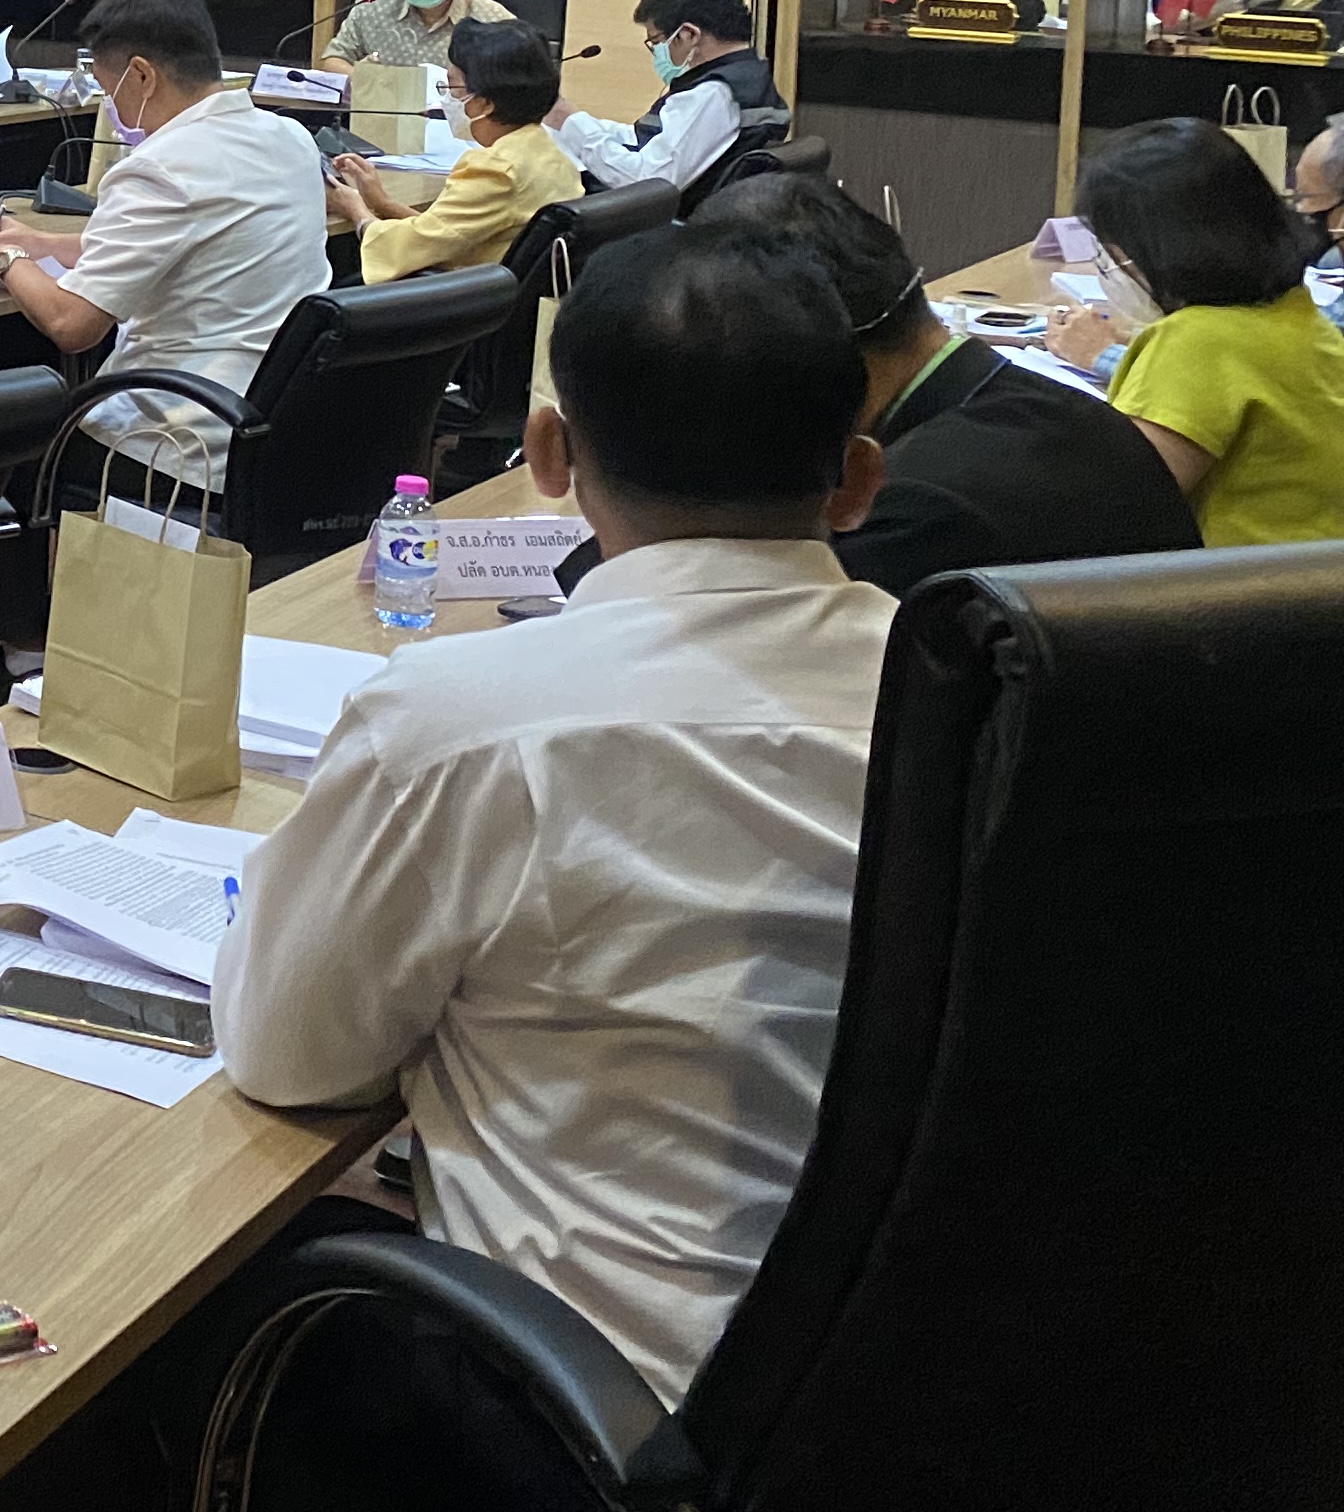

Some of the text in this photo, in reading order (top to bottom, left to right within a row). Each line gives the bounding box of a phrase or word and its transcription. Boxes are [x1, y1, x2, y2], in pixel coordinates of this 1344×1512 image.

[929, 6, 998, 21] MYANMAR
[457, 560, 555, 579] ปลัด อบต.หนอ
